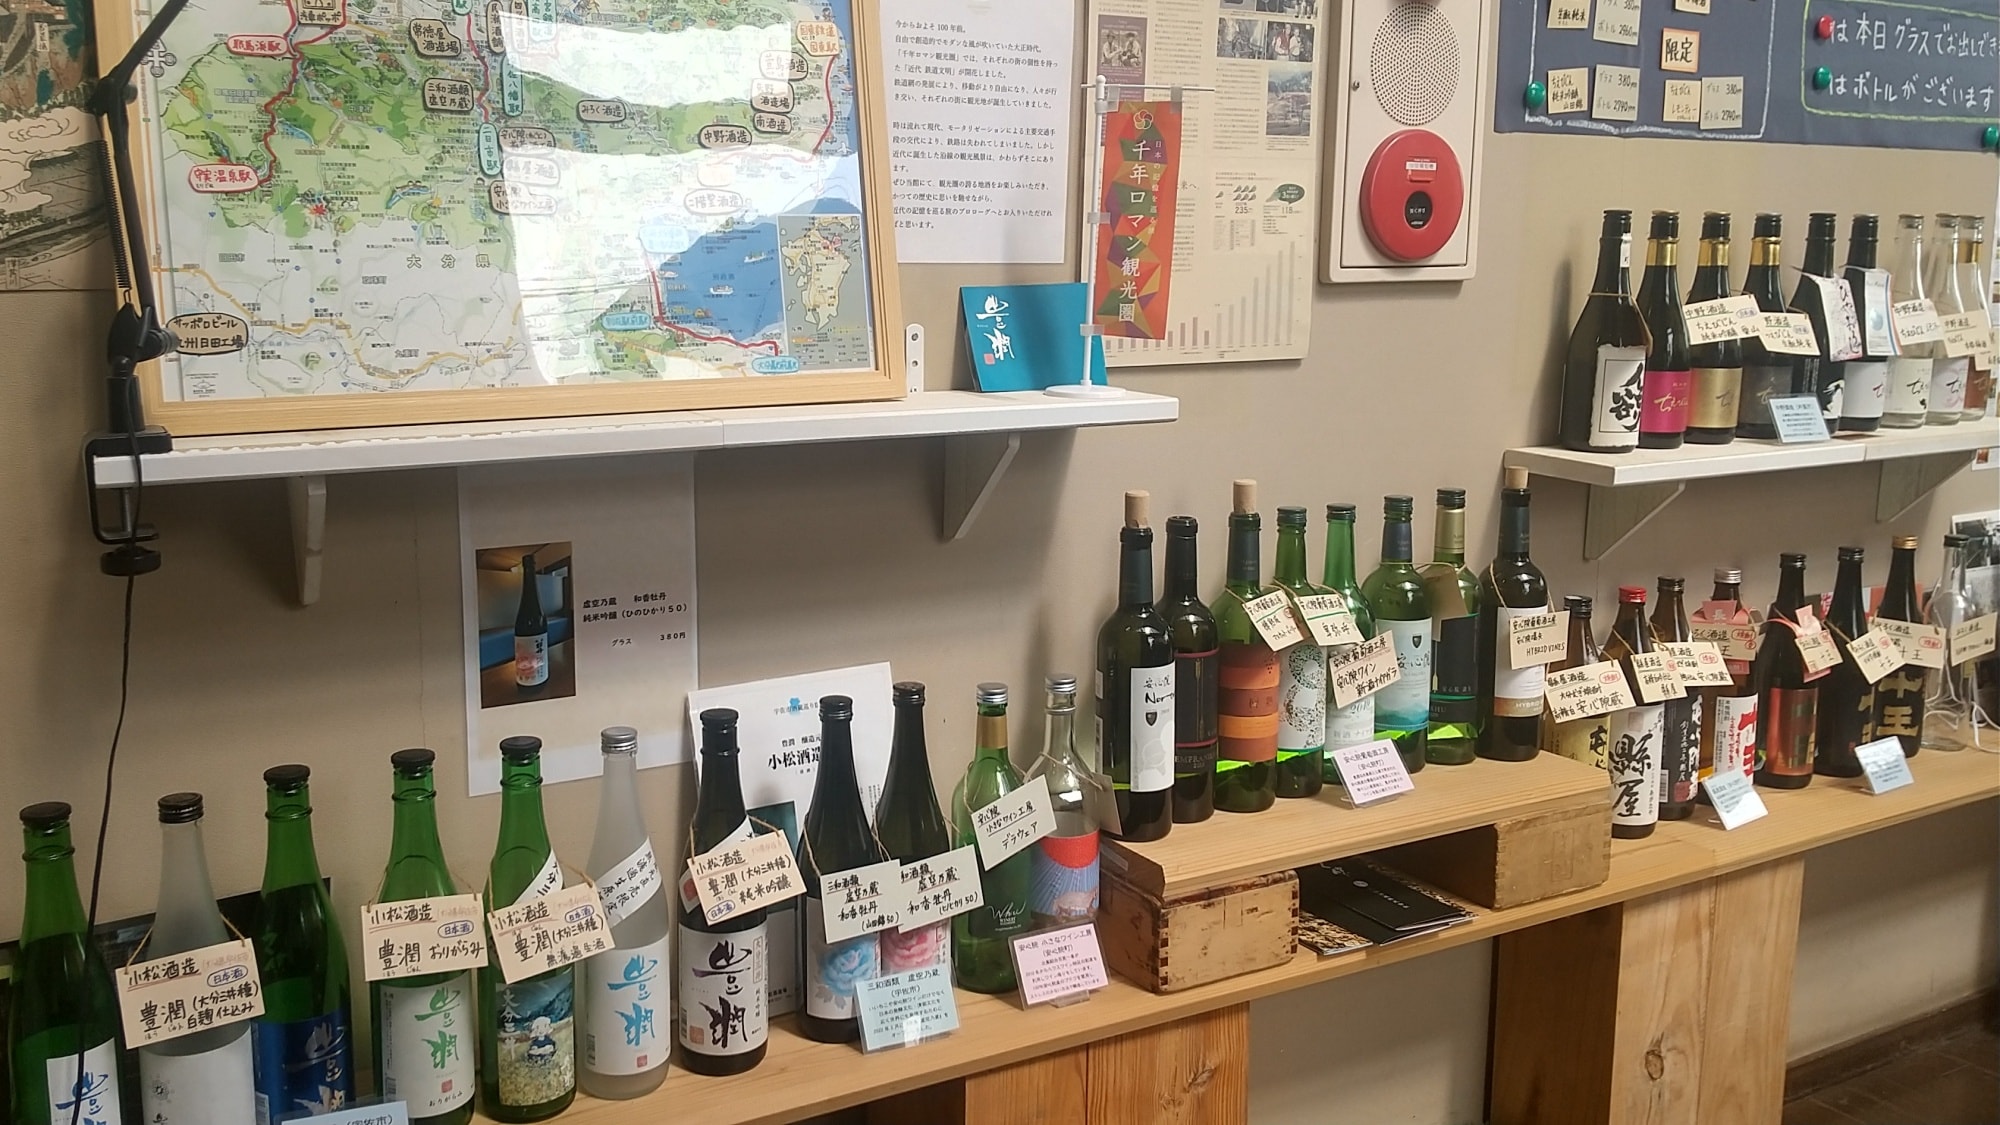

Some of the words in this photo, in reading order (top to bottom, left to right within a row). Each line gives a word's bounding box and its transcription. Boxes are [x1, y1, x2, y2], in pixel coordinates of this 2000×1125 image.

[1664, 36, 1694, 63] 限定
[704, 130, 750, 144] 中野酒造
[1119, 138, 1152, 323] 千年ロマン観光圏
[173, 317, 239, 331] サッポロビール
[1837, 284, 1862, 355] ひやおろし
[582, 597, 618, 610] 虚空乃蔵
[633, 592, 668, 604] 和香牡丹
[611, 638, 633, 648] グラス
[1001, 820, 1040, 850] デラウェア
[695, 848, 748, 877] 小松酒造
[707, 871, 740, 898] 豊潤
[738, 872, 793, 906] 純米吟醸
[826, 873, 863, 892] 三和酒類
[370, 903, 435, 927] 小松酒造
[493, 900, 552, 930] 小松酒造
[837, 900, 879, 922] 和香牡丹
[907, 887, 953, 915] 和香牡丹
[443, 922, 472, 936] 日本酒
[377, 937, 423, 971] 豊潤
[427, 939, 486, 962] おりがらみ
[513, 930, 554, 963] 豊潤
[127, 957, 202, 987] 小松酒造
[212, 967, 245, 985] 日本酒
[607, 953, 659, 1047] 豊潤
[691, 938, 753, 1050] 豊潤
[139, 1000, 188, 1034] 豊潤
[414, 985, 462, 1070] 豊潤
